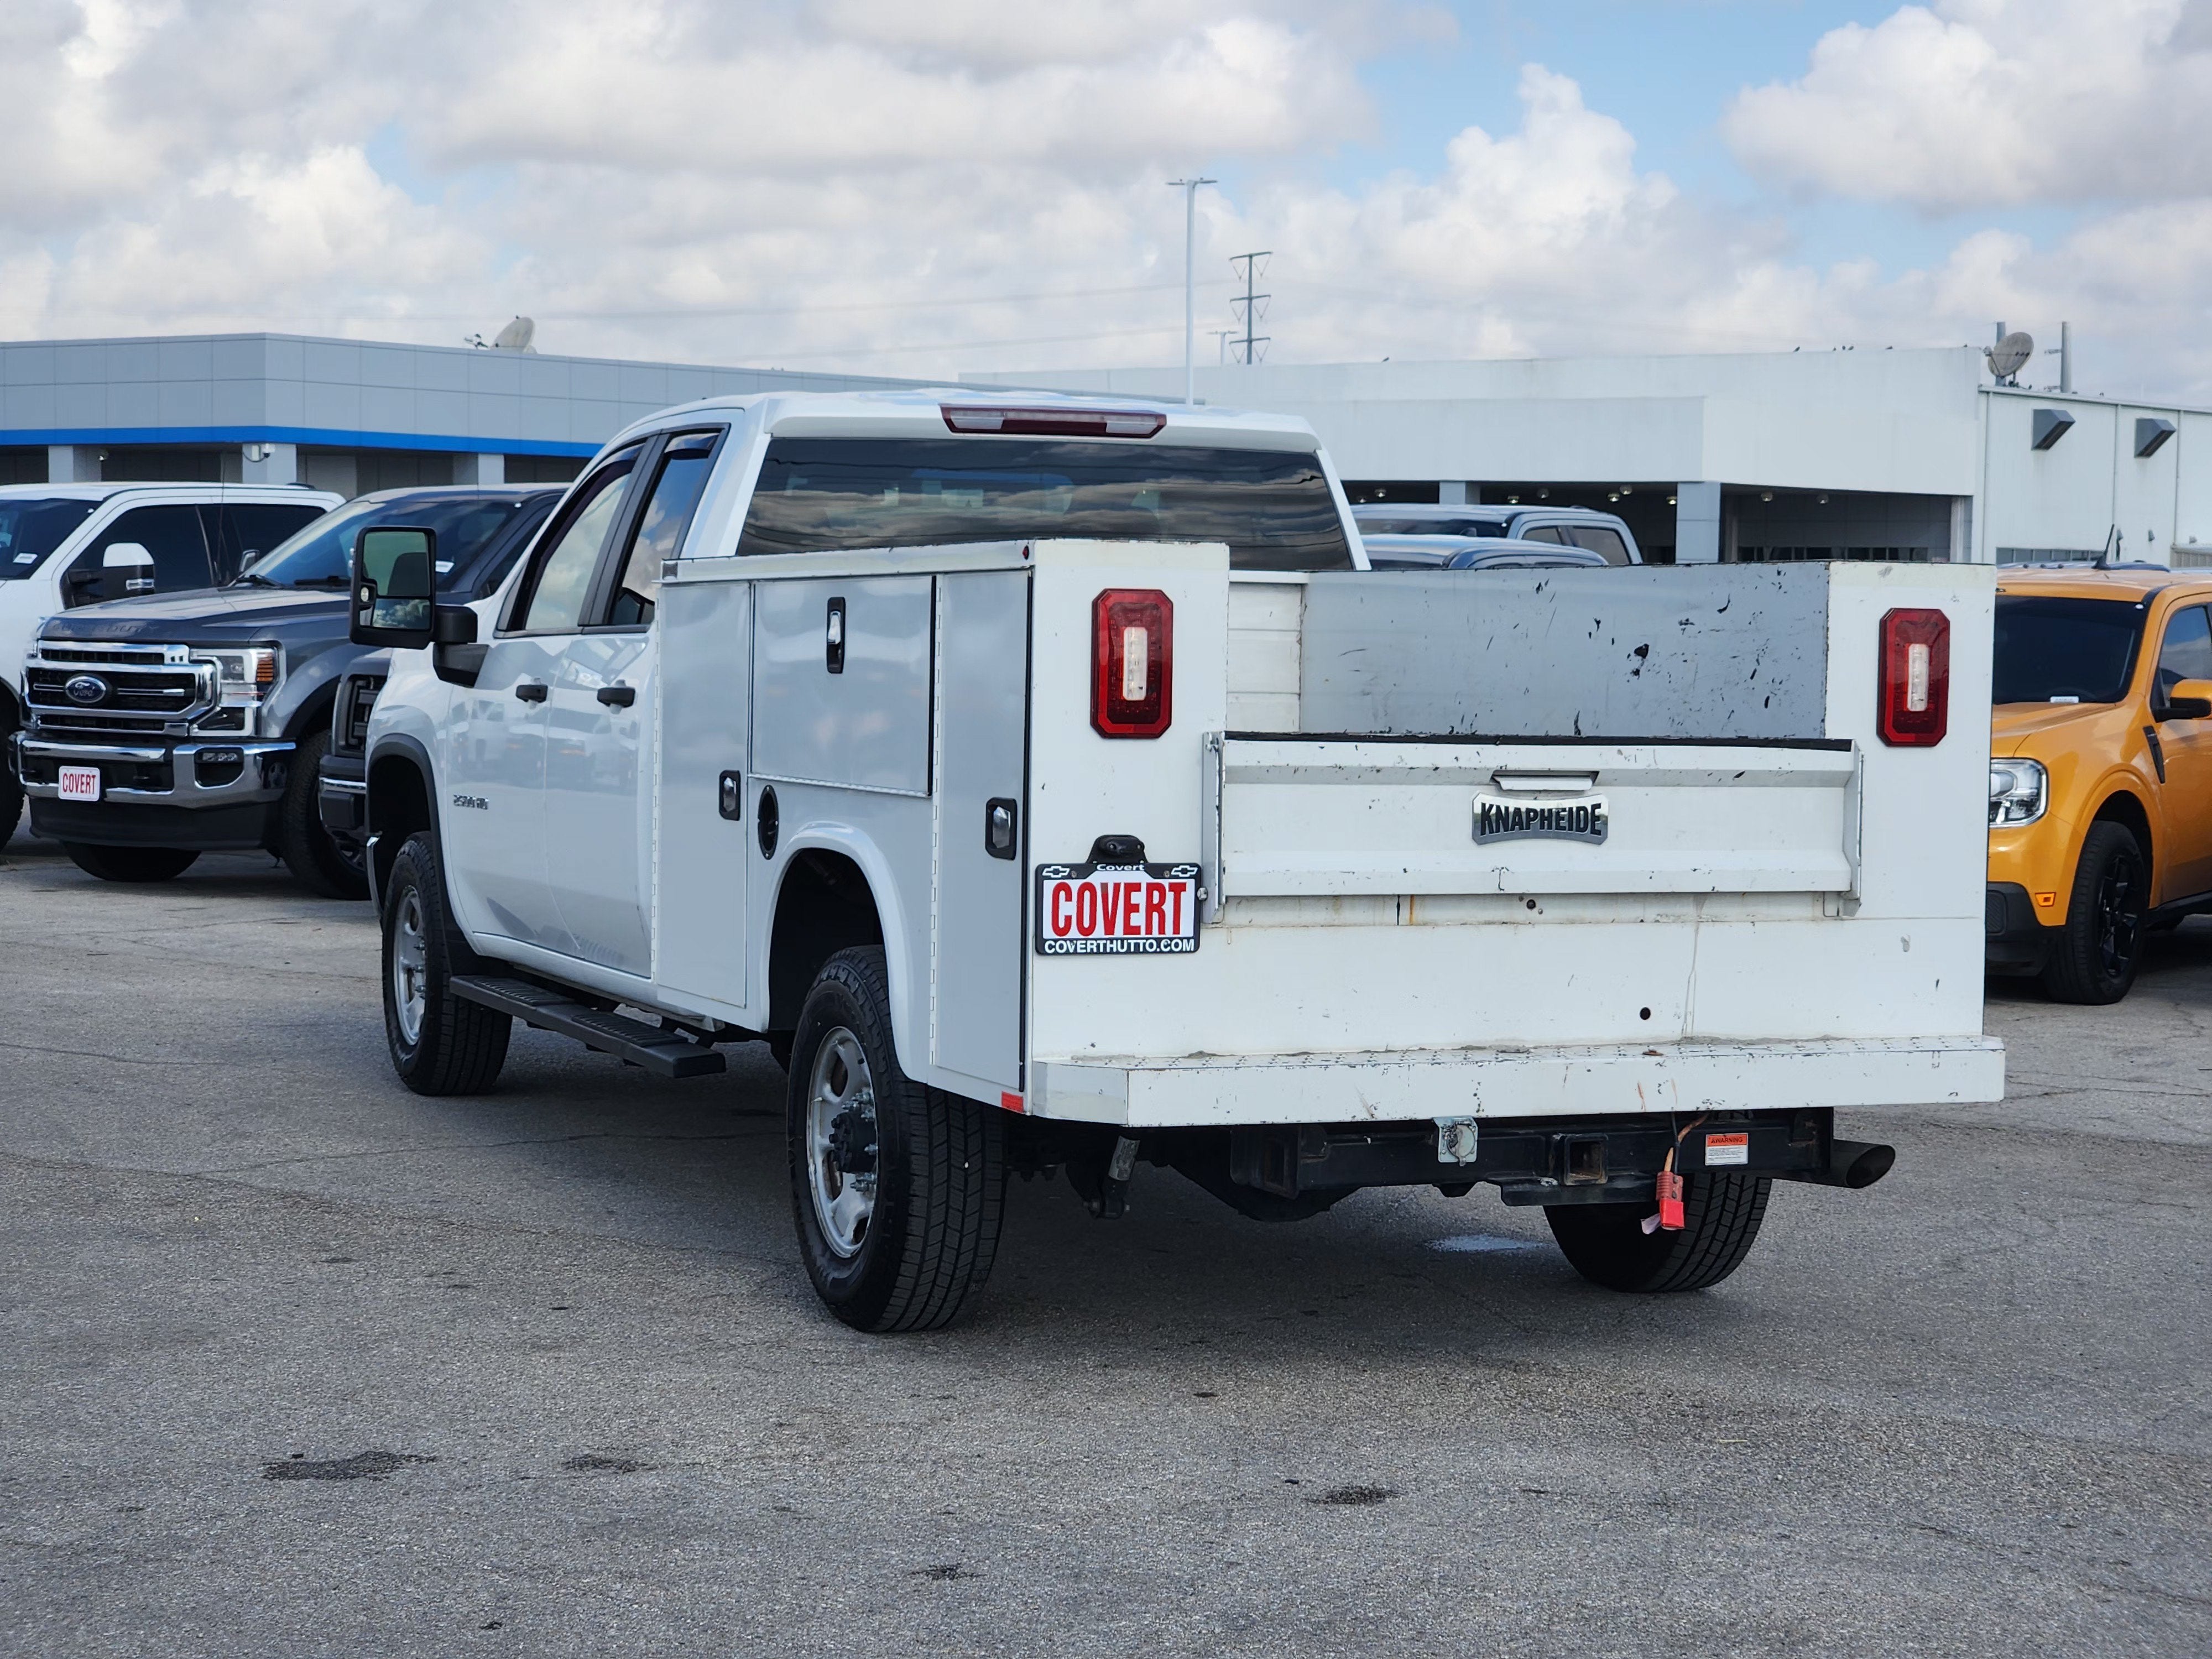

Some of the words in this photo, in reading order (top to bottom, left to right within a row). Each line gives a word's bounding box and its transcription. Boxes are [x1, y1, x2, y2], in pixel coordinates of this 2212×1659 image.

[62, 773, 96, 795] COVERT
[1480, 801, 1603, 837] KNAPHEIDE
[1051, 881, 1187, 937] COVERT
[1044, 939, 1195, 954] COVERTHUTTO.COM
